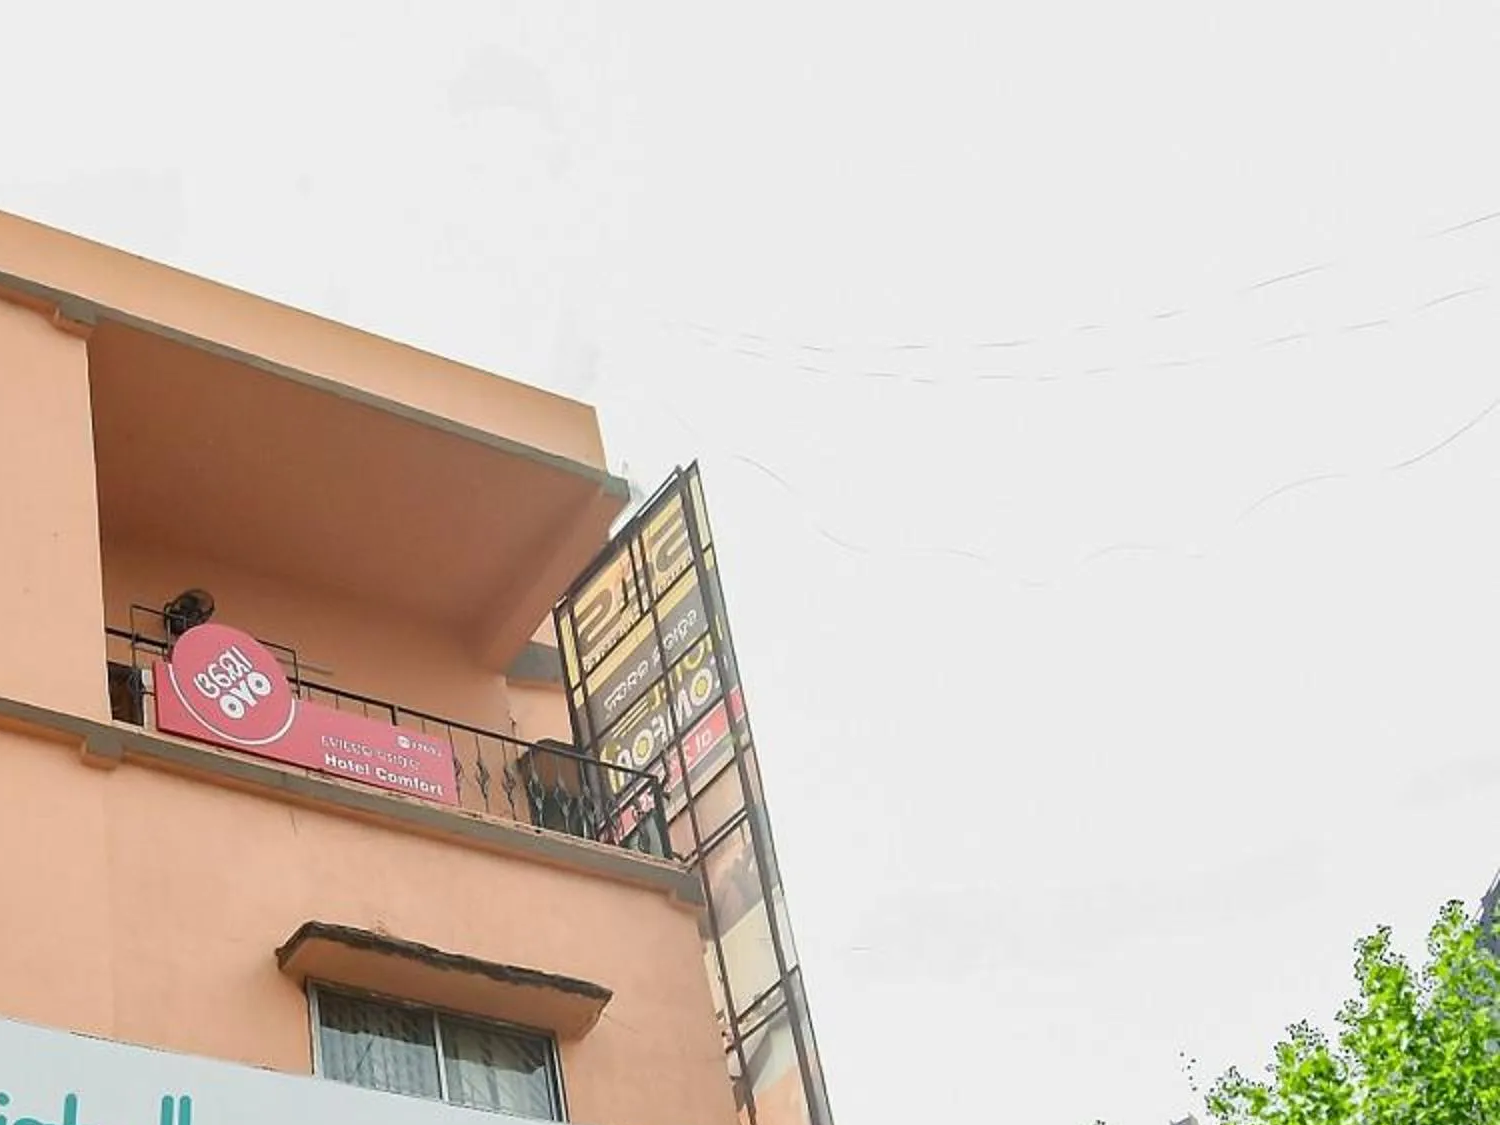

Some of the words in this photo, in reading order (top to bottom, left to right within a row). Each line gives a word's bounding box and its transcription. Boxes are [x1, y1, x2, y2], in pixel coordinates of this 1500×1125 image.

[220, 670, 272, 719] OYO
[324, 752, 370, 776] Hotel
[375, 767, 444, 797] Comfort
